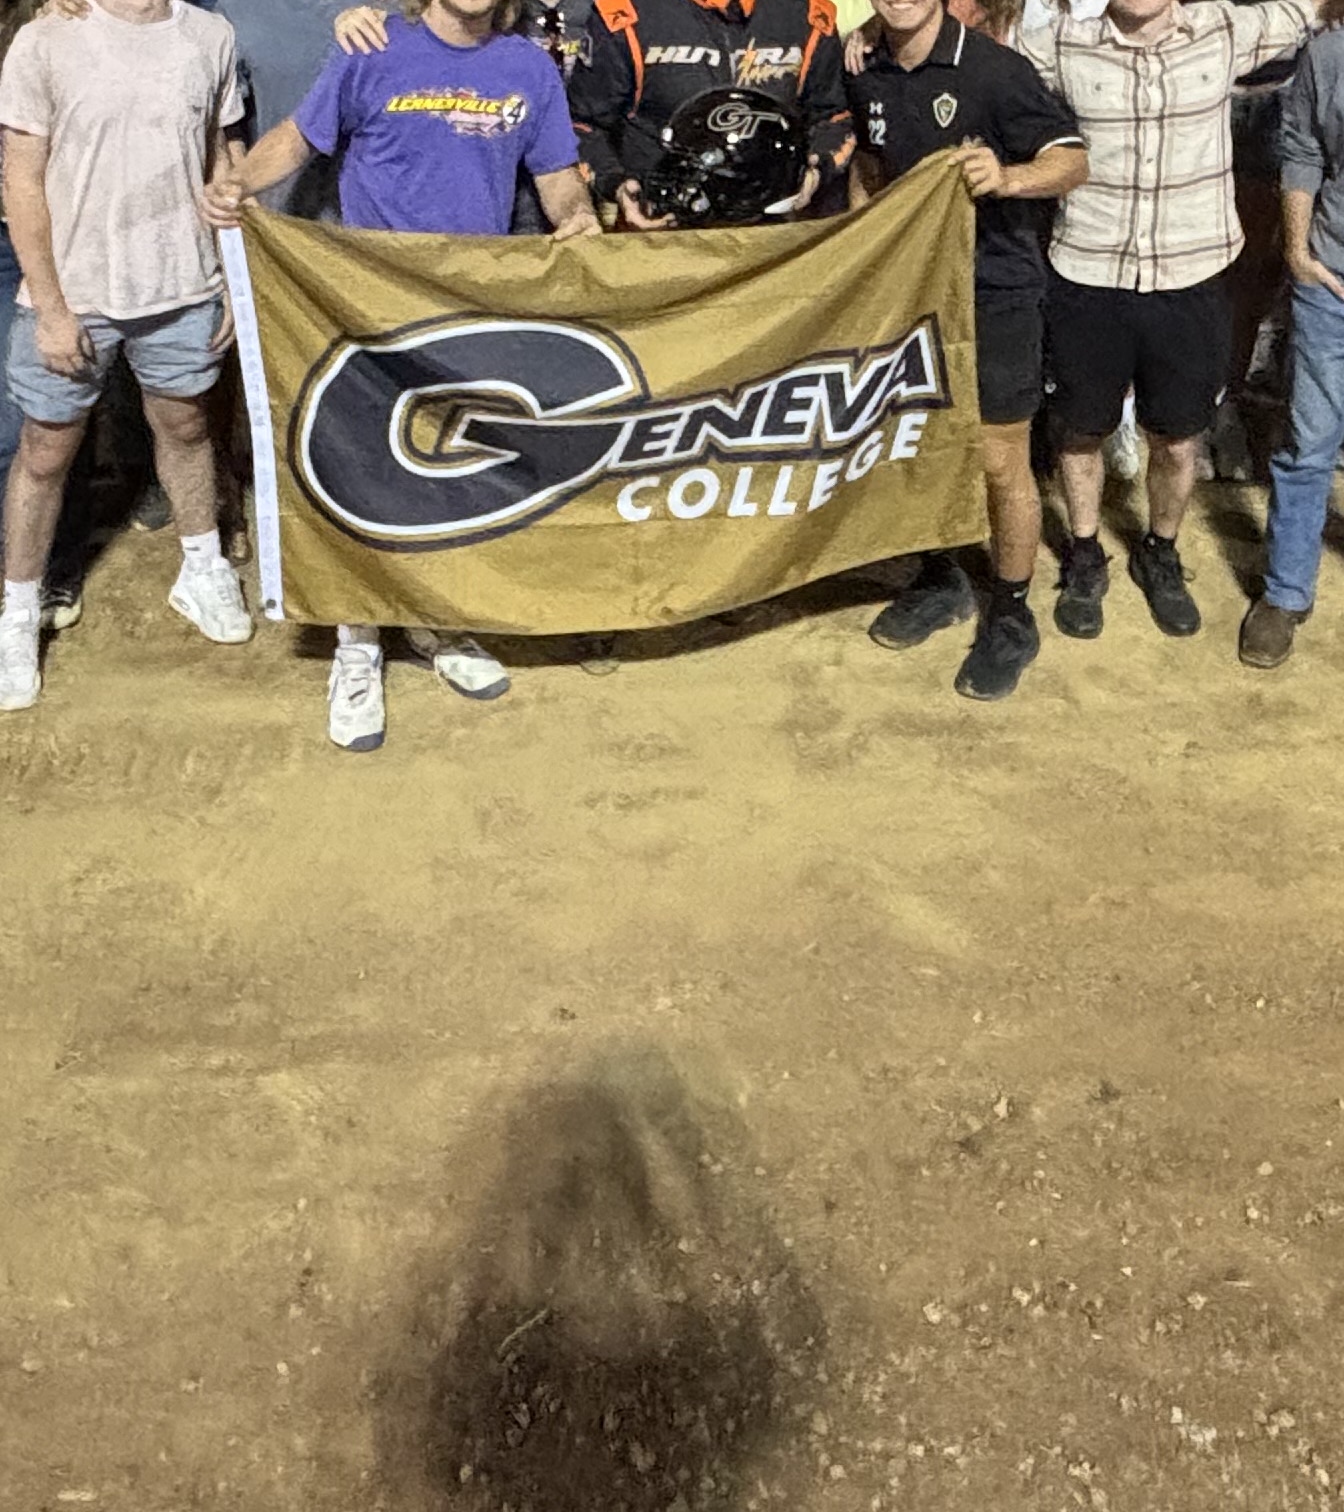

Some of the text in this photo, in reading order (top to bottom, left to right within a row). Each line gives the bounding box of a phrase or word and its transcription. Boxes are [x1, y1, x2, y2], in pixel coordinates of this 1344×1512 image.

[386, 96, 502, 114] LERNERVILLE
[867, 119, 887, 146] 22
[296, 315, 945, 544] GENEVA
[616, 411, 926, 523] COLLEGE
